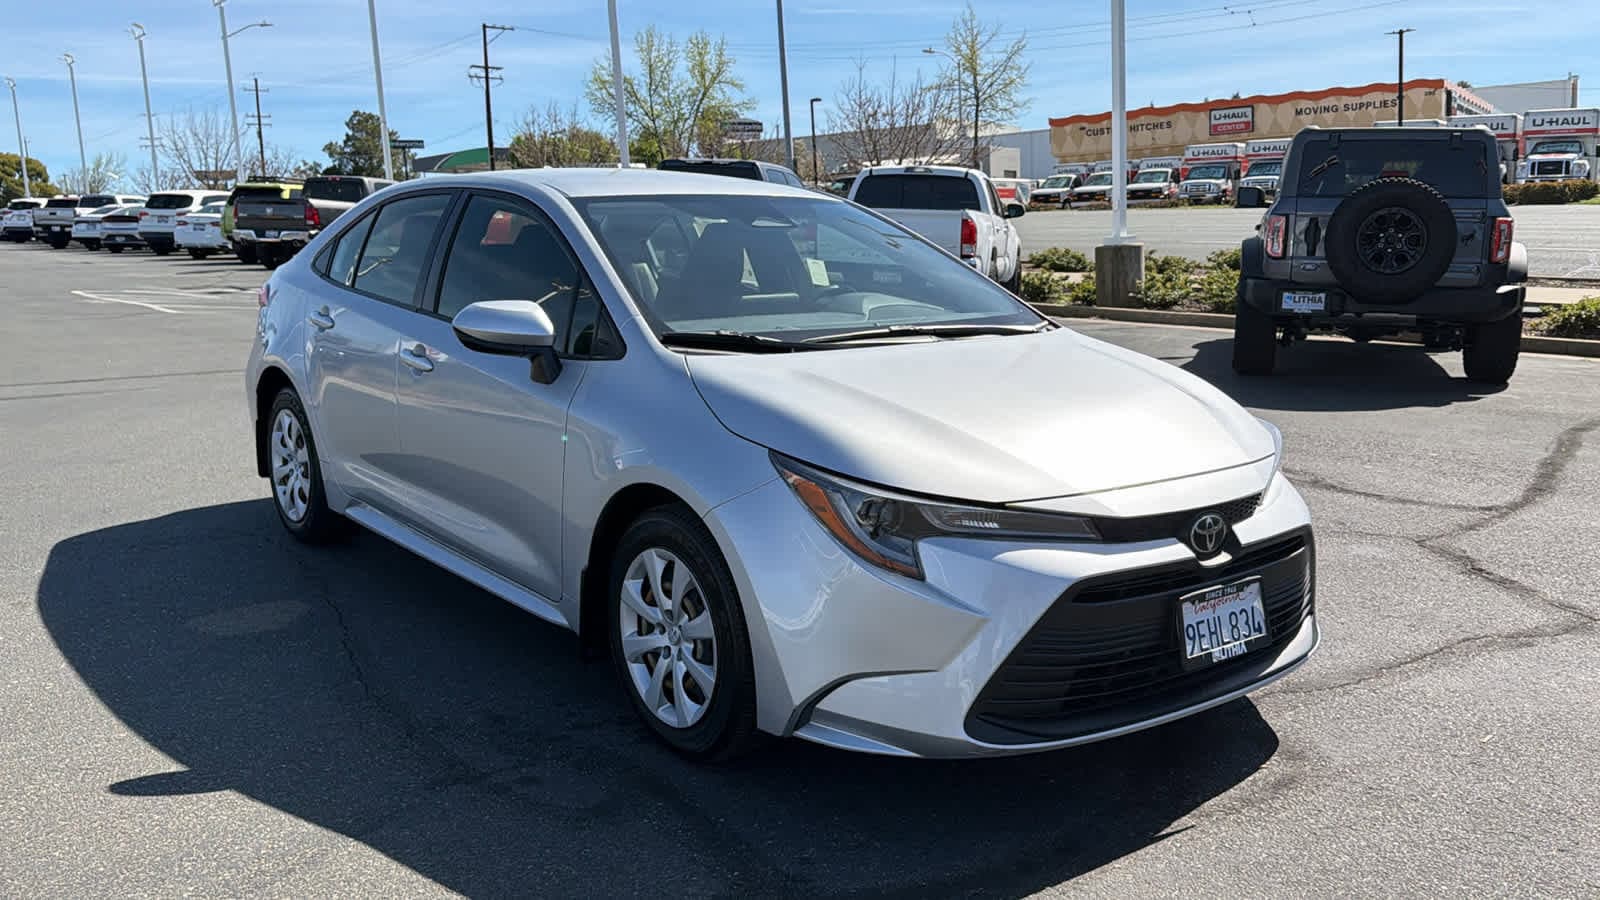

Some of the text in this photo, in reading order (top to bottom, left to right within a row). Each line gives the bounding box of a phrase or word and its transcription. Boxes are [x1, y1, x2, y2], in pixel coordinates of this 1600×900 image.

[1295, 99, 1398, 116] MOVING SUPPLIES
[1213, 112, 1249, 121] U-HAUL
[1532, 116, 1591, 127] U-HAUL
[1086, 121, 1173, 137] CUST HITCHES
[1217, 124, 1246, 132] CENTER
[1192, 149, 1230, 157] U-HAUL
[1293, 295, 1323, 304] LITHIA
[1185, 605, 1263, 658] 9EHL834
